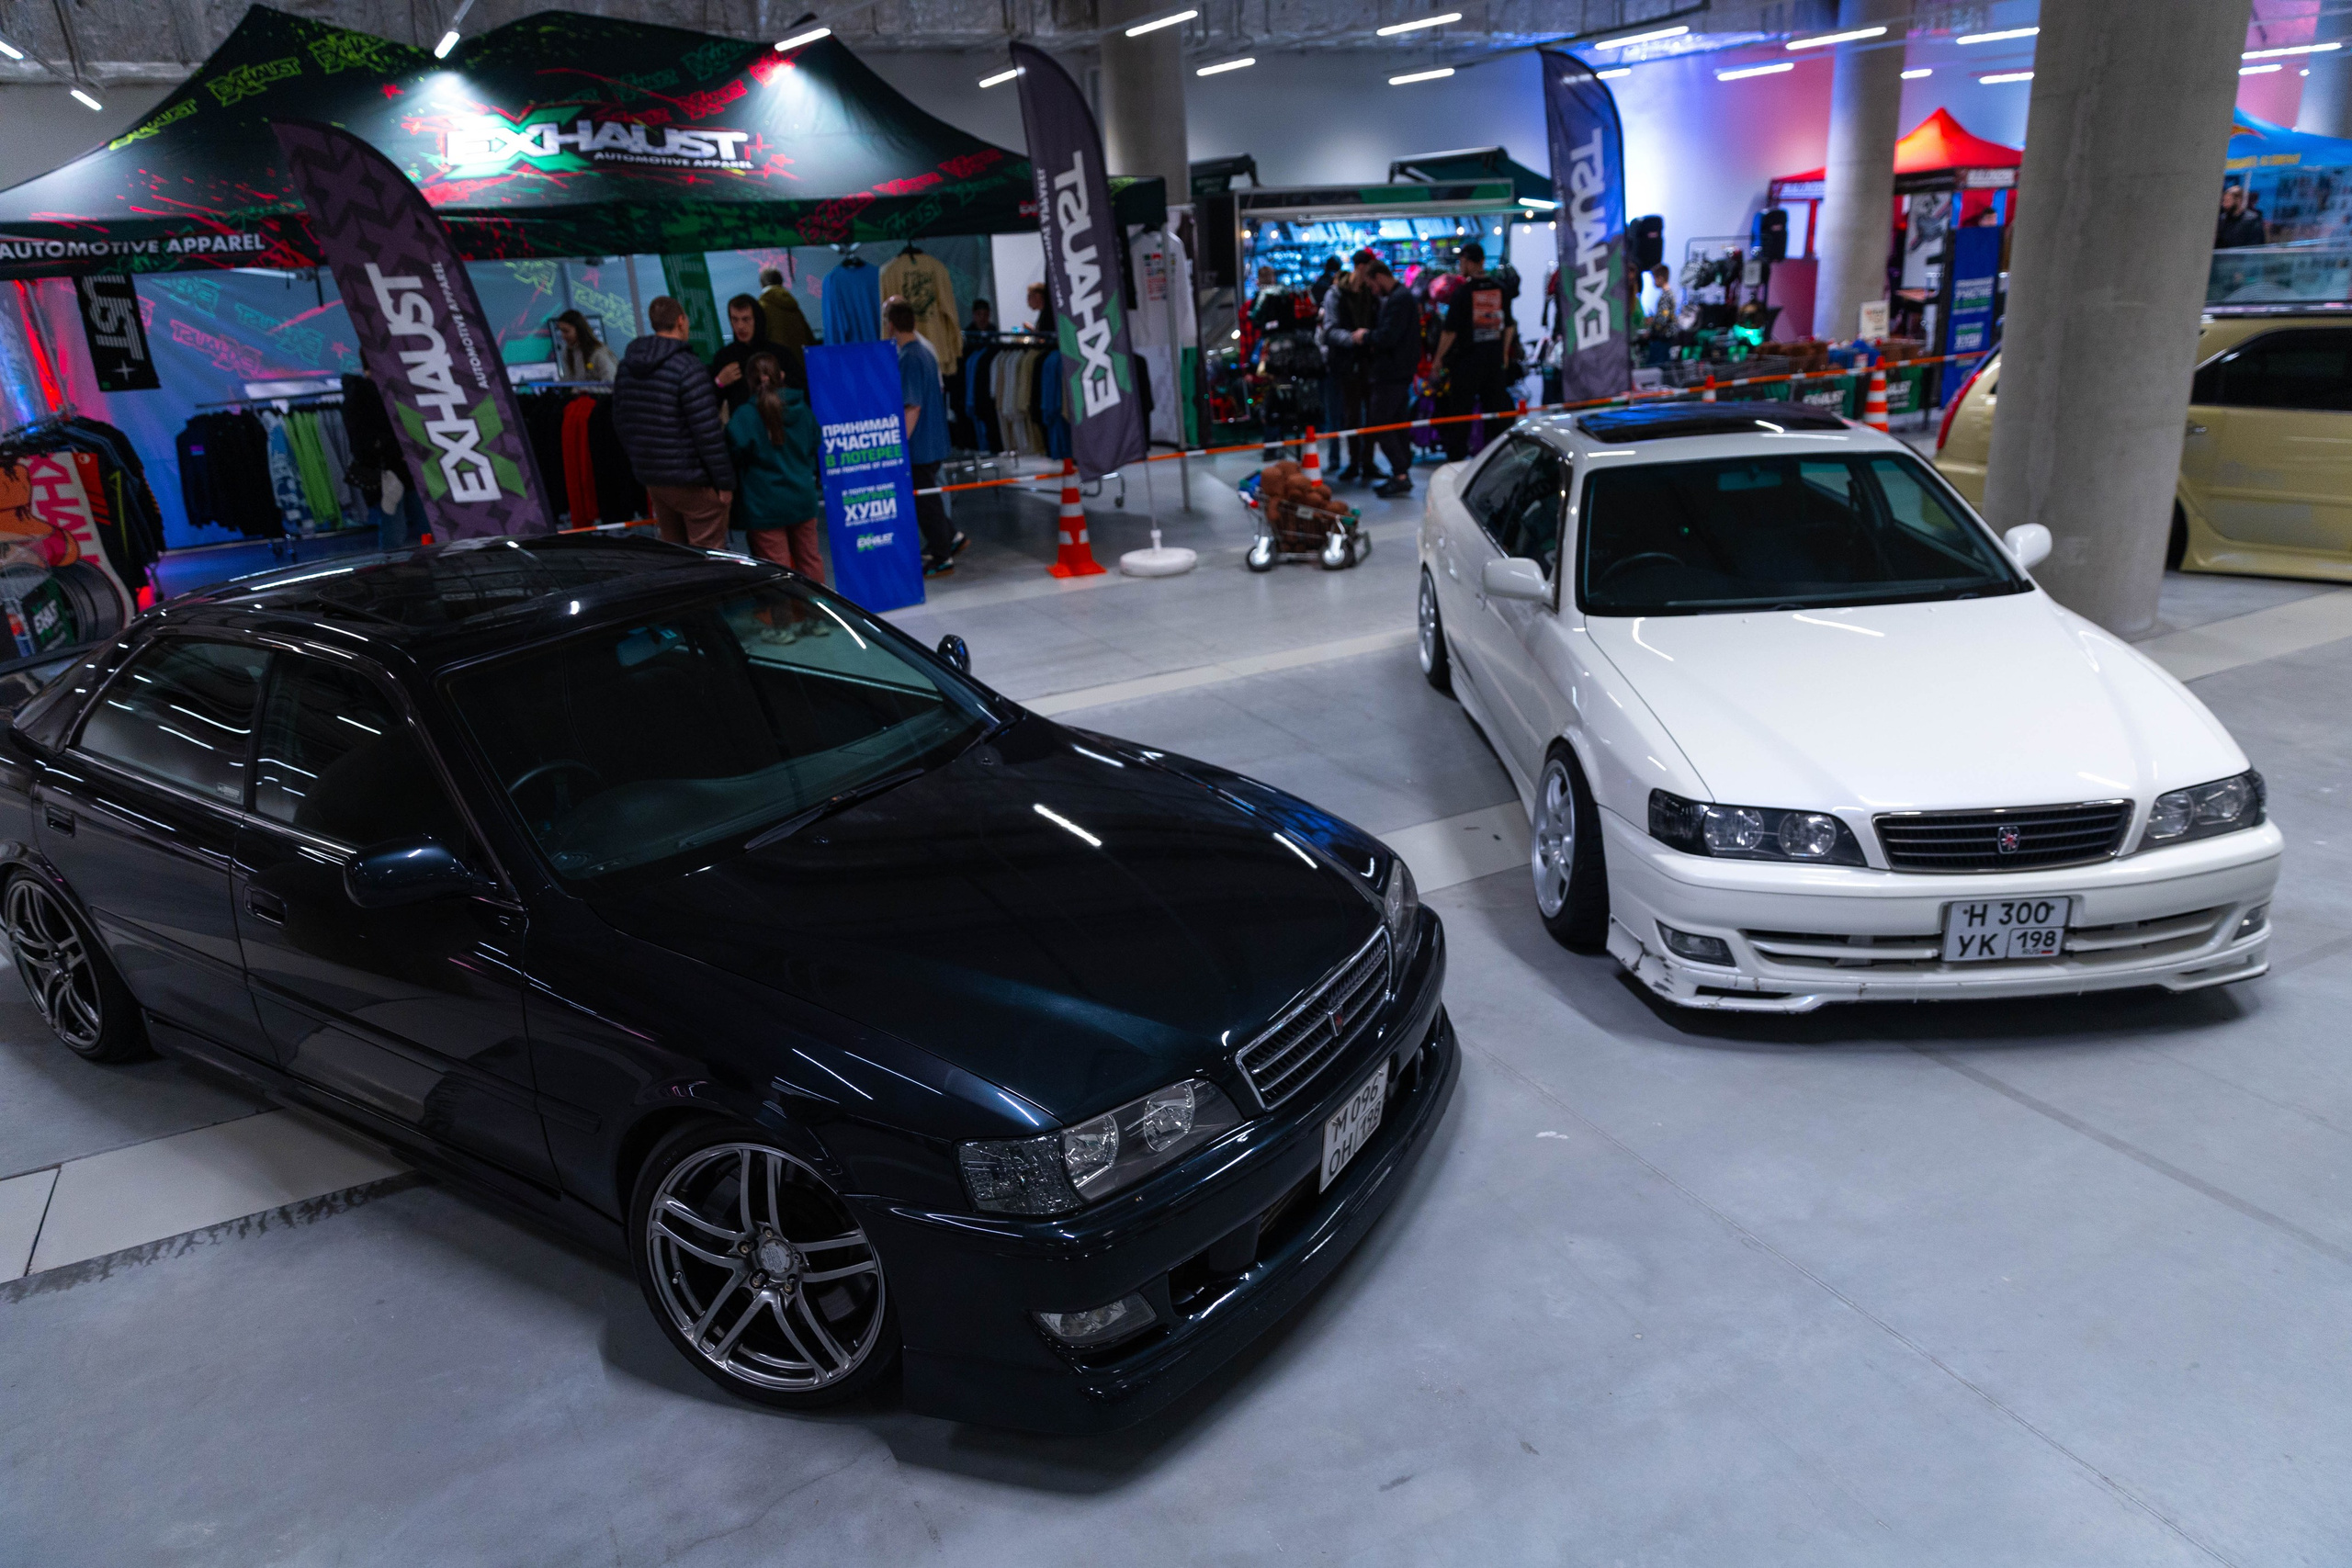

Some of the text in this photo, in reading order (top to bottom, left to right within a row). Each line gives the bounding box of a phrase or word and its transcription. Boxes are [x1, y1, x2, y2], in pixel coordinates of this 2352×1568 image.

[447, 119, 749, 166] EXHAUST
[594, 152, 754, 169] AUTOMOTIVE APPAREL
[0, 232, 266, 260] AUTOMOTIVE APPAREL
[431, 262, 490, 389] AUTOMOTIVE APPAREL
[364, 263, 503, 503] EXHAUST
[822, 415, 899, 438] ПРИНИМАЙ
[824, 429, 901, 454] УЧАСТИЕ
[825, 454, 836, 468] В
[840, 445, 903, 466] ЛОТЕРЕЕ
[843, 497, 897, 522] ХУДИ
[1998, 901, 2051, 925] 300
[2017, 931, 2056, 948] 198
[1351, 1076, 1378, 1122] 096
[1360, 1100, 1382, 1134] 198
